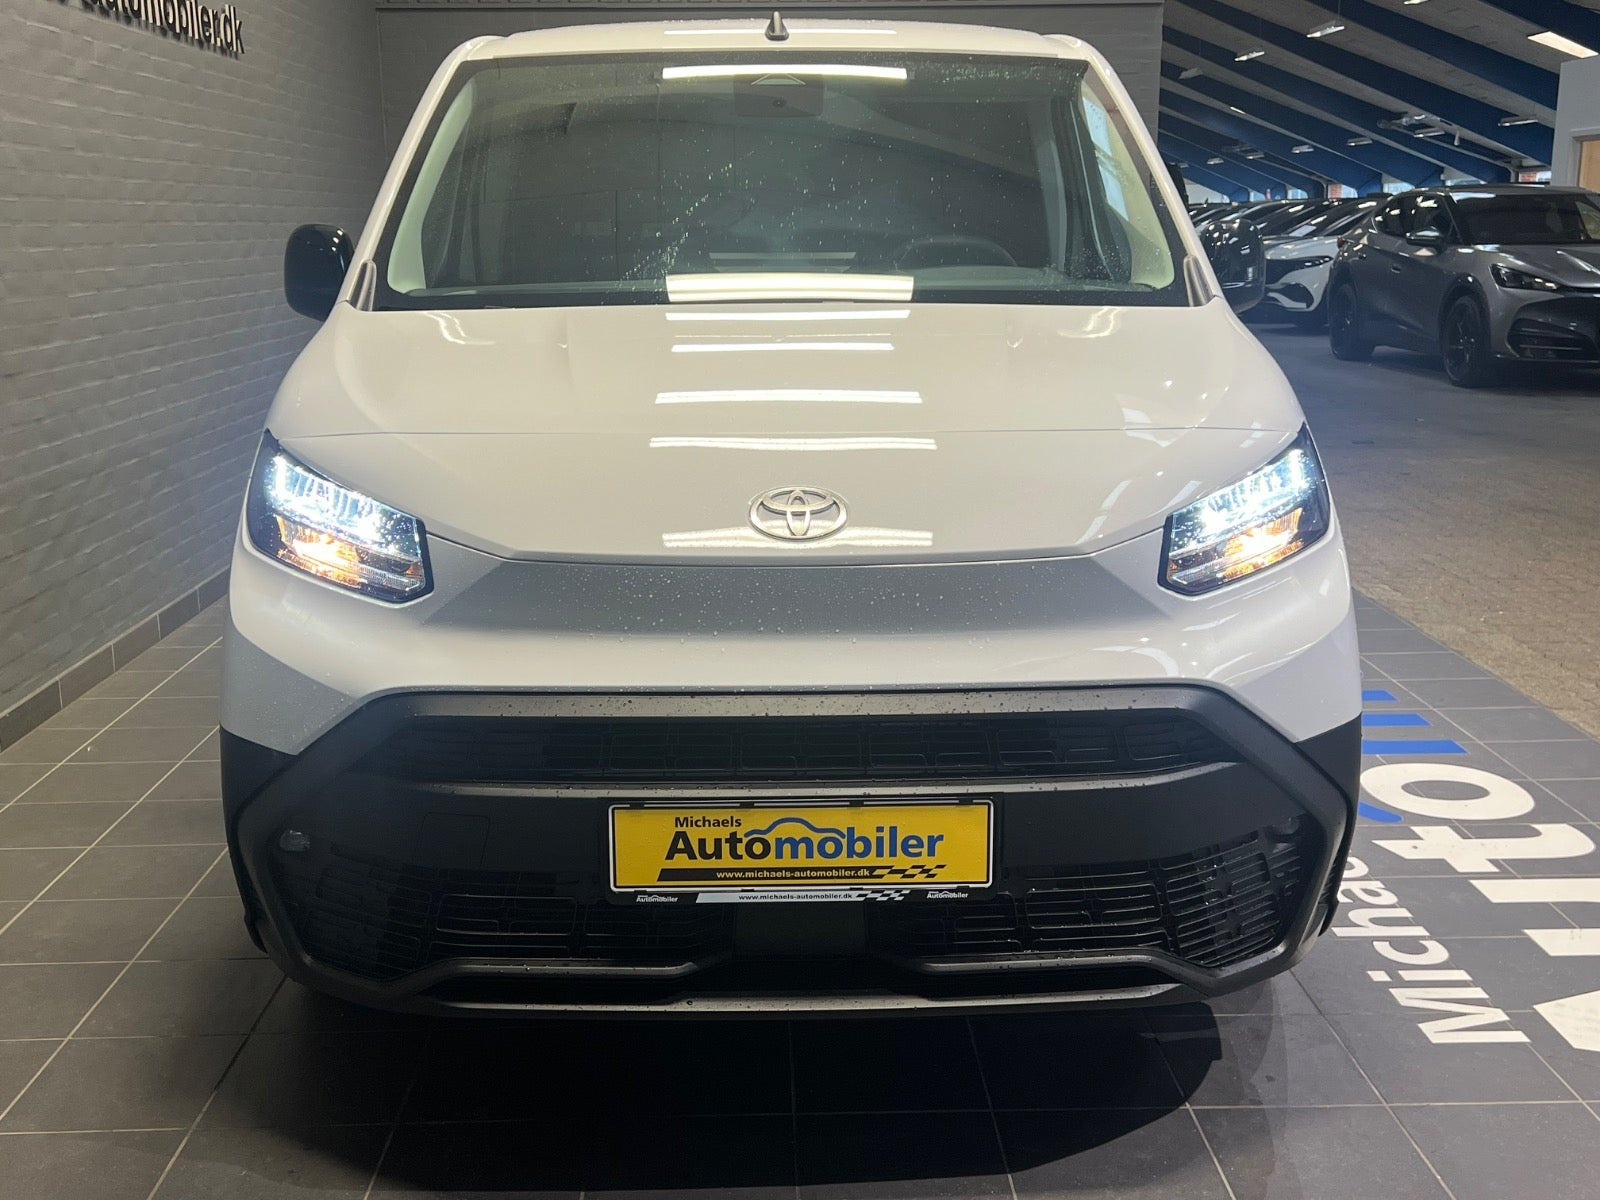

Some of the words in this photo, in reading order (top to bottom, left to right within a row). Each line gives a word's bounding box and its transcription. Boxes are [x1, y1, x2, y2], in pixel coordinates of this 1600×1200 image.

[674, 816, 742, 828] Michaels
[664, 826, 944, 861] Automobiler
[716, 868, 870, 879] www.michaels-automobiler.dk
[738, 893, 853, 901] www.michaels-automobiler.dk
